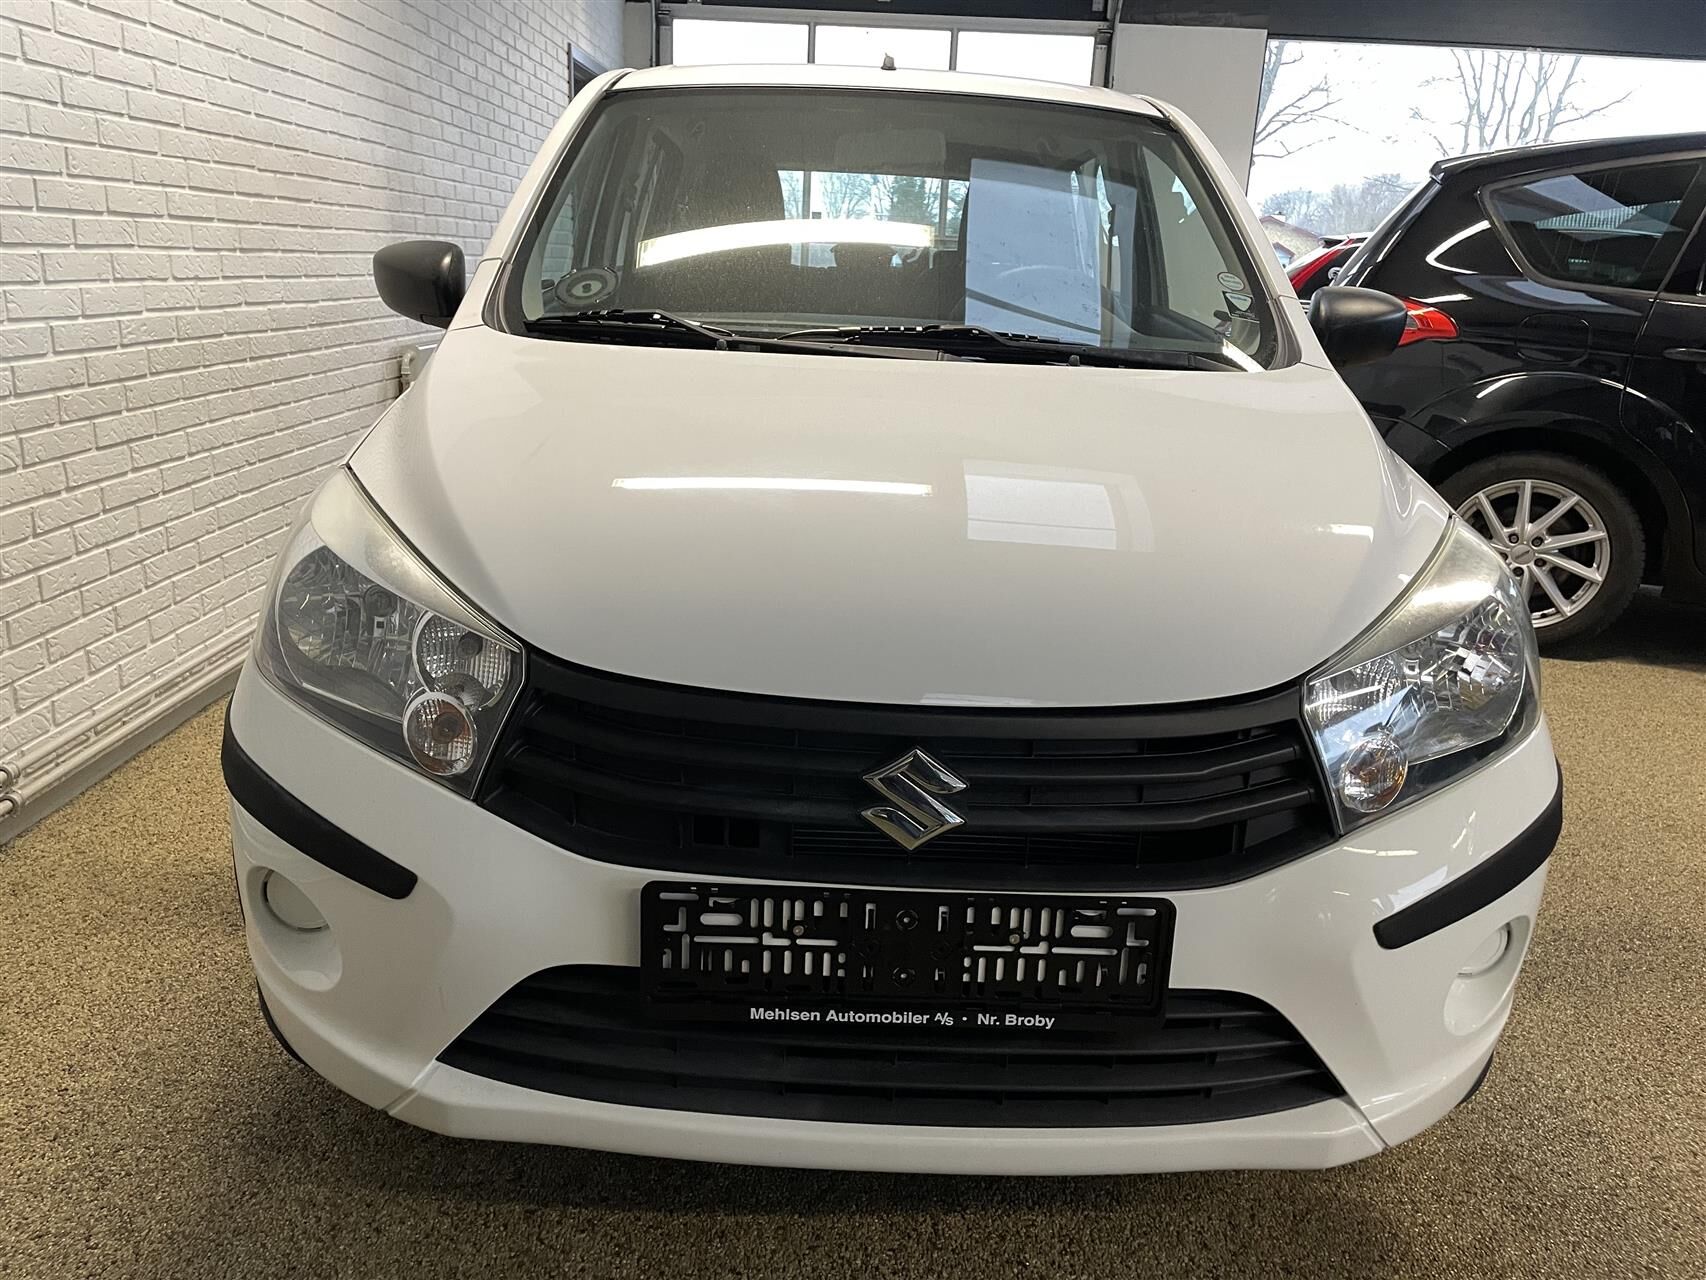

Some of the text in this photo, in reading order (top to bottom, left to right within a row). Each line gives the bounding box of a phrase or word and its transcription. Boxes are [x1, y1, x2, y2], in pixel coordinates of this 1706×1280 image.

[750, 1007, 821, 1022] Mehlsen
[825, 1009, 930, 1025] Automobiler
[977, 1013, 1000, 1026] Nr.
[1004, 1014, 1056, 1030] Broby
